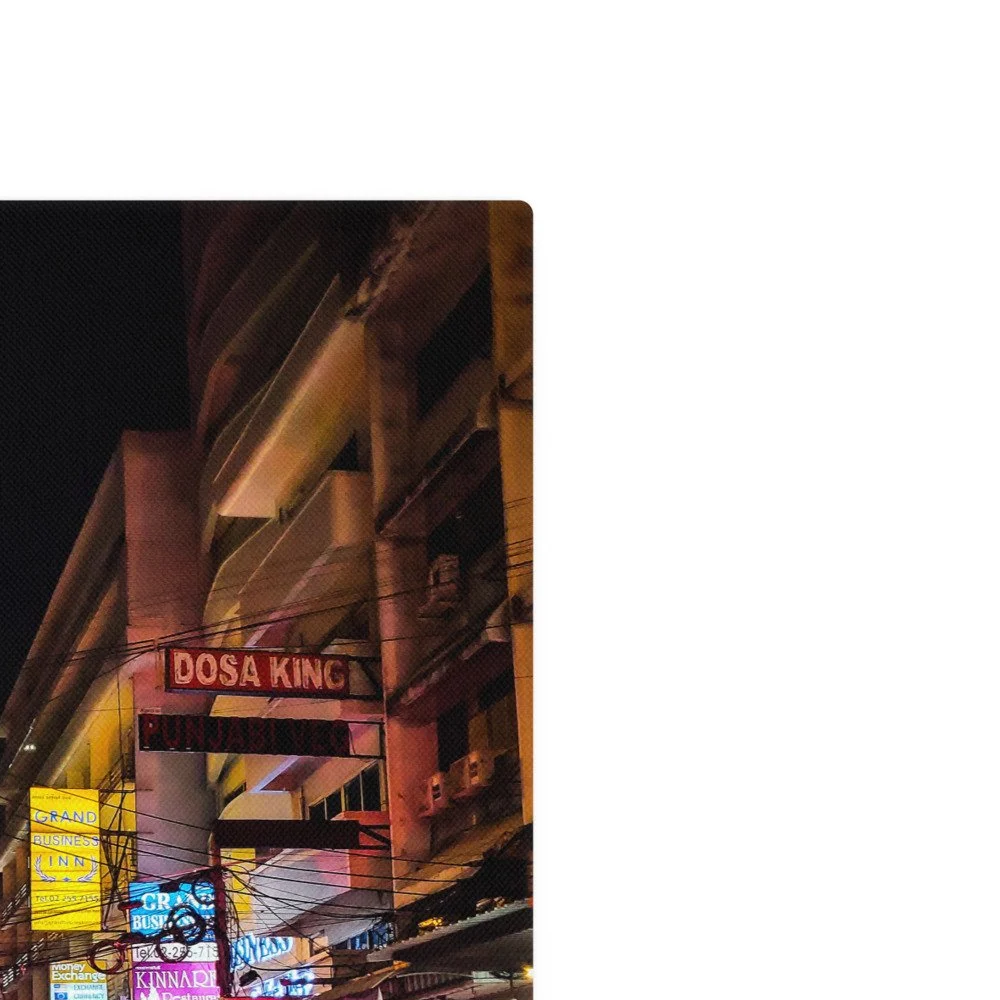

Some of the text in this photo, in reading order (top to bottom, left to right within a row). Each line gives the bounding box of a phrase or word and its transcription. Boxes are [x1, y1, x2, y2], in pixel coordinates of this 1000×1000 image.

[173, 652, 346, 690] DOSA KING
[35, 810, 97, 823] GRAND
[34, 836, 99, 846] BUSINESS
[49, 856, 85, 867] INN
[53, 963, 85, 972] Money
[53, 971, 106, 982] Exchange
